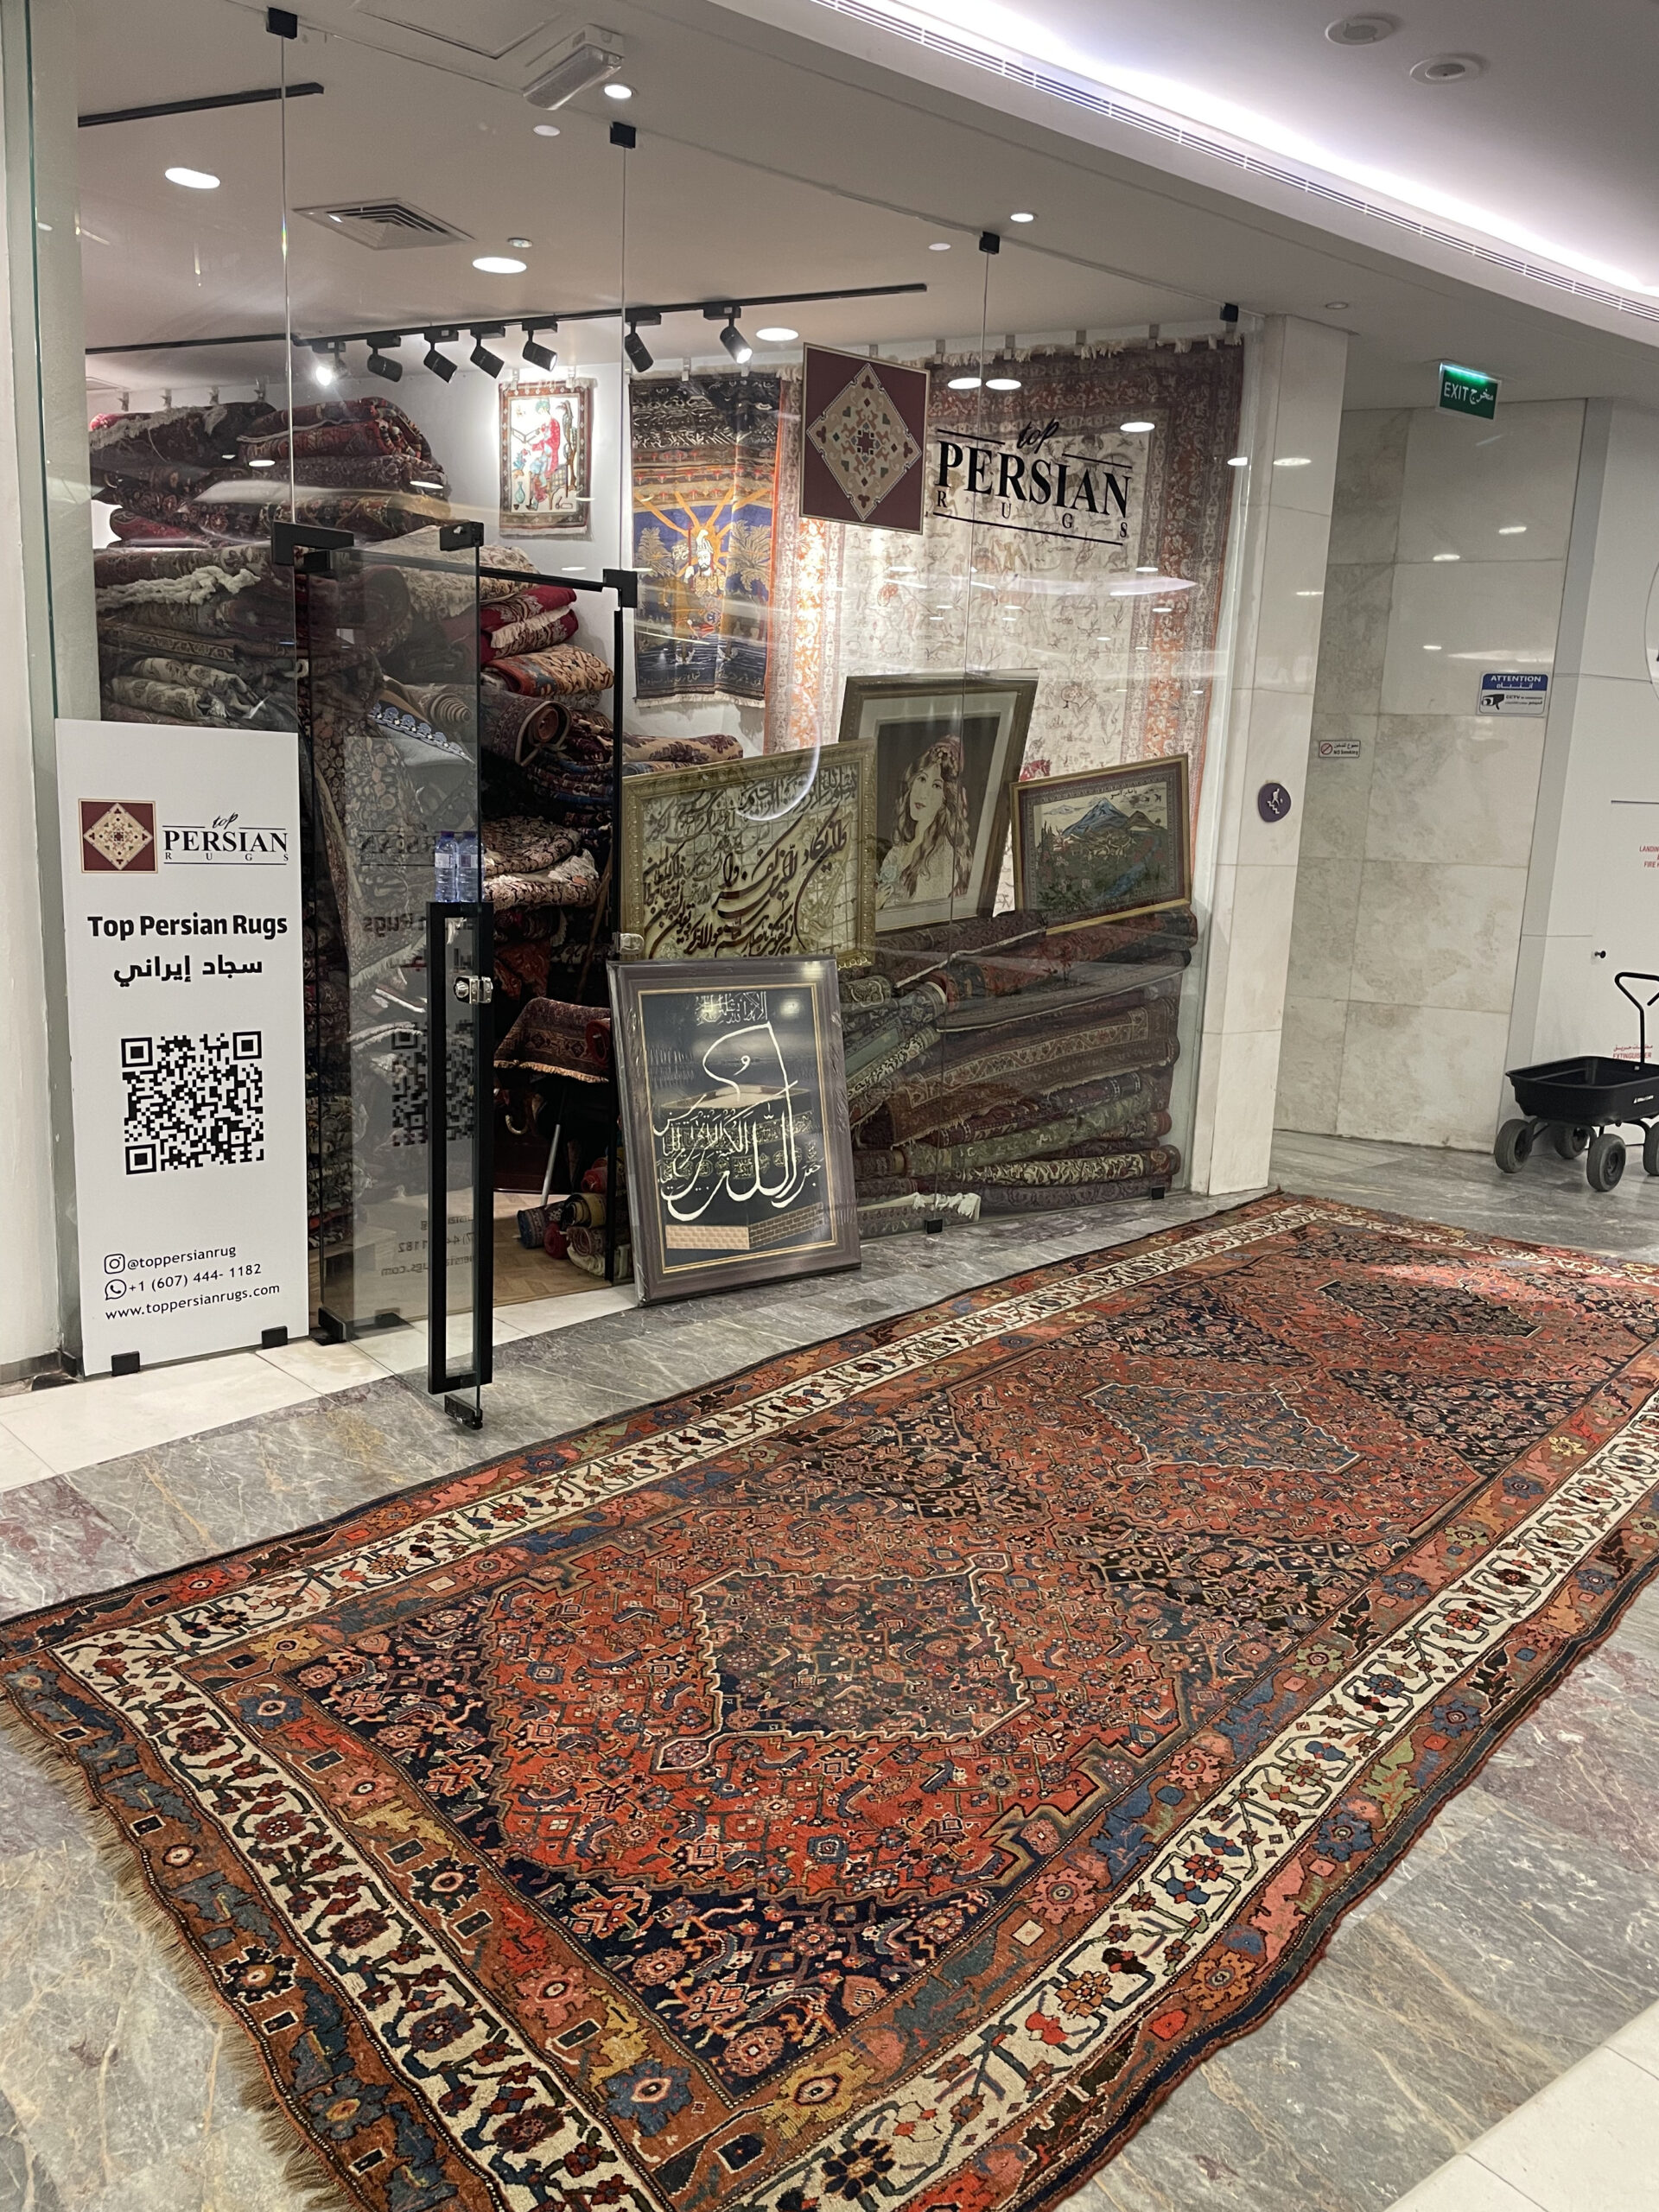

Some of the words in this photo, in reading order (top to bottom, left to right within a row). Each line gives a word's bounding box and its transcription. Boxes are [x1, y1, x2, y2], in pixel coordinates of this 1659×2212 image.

[1444, 382, 1469, 401] EXIT
[1470, 388, 1494, 404] مخرج
[1016, 418, 1059, 454] top
[935, 440, 1132, 518] PERSIAN
[937, 490, 1128, 538] RUGS
[213, 812, 238, 830] top
[164, 830, 288, 852] PERSIAN
[165, 851, 289, 861] RUGS
[87, 916, 134, 941] Top
[140, 912, 227, 936] Persian
[232, 914, 288, 940] Rugs
[113, 955, 191, 988] إيراني
[202, 954, 263, 979] سجاد
[127, 1246, 236, 1270] @toppersianrug
[129, 1281, 144, 1293] +1
[151, 1274, 188, 1293] (607)
[193, 1269, 224, 1283] 444-
[229, 1263, 262, 1278] 1182
[105, 1284, 280, 1320] www.toppersianrugs.com
